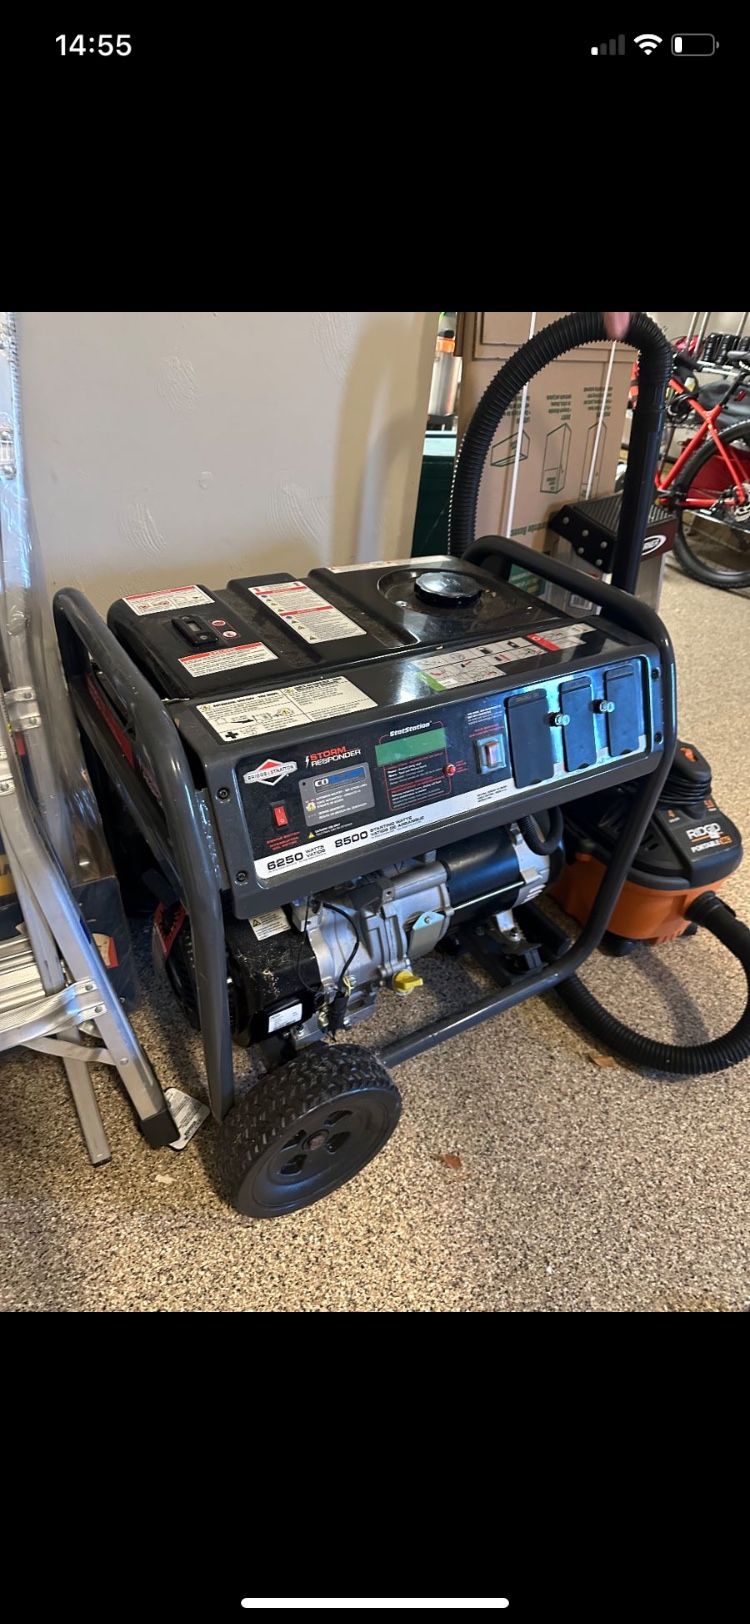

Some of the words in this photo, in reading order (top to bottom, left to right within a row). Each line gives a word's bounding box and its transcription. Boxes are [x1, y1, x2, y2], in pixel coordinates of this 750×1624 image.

[310, 746, 347, 760] STORM
[311, 749, 361, 767] RESPONDER
[270, 765, 295, 775] STRATTON
[335, 831, 369, 848] 8500
[686, 822, 721, 840] RIDGID
[305, 845, 325, 854] WATTS
[267, 852, 304, 870] 6250
